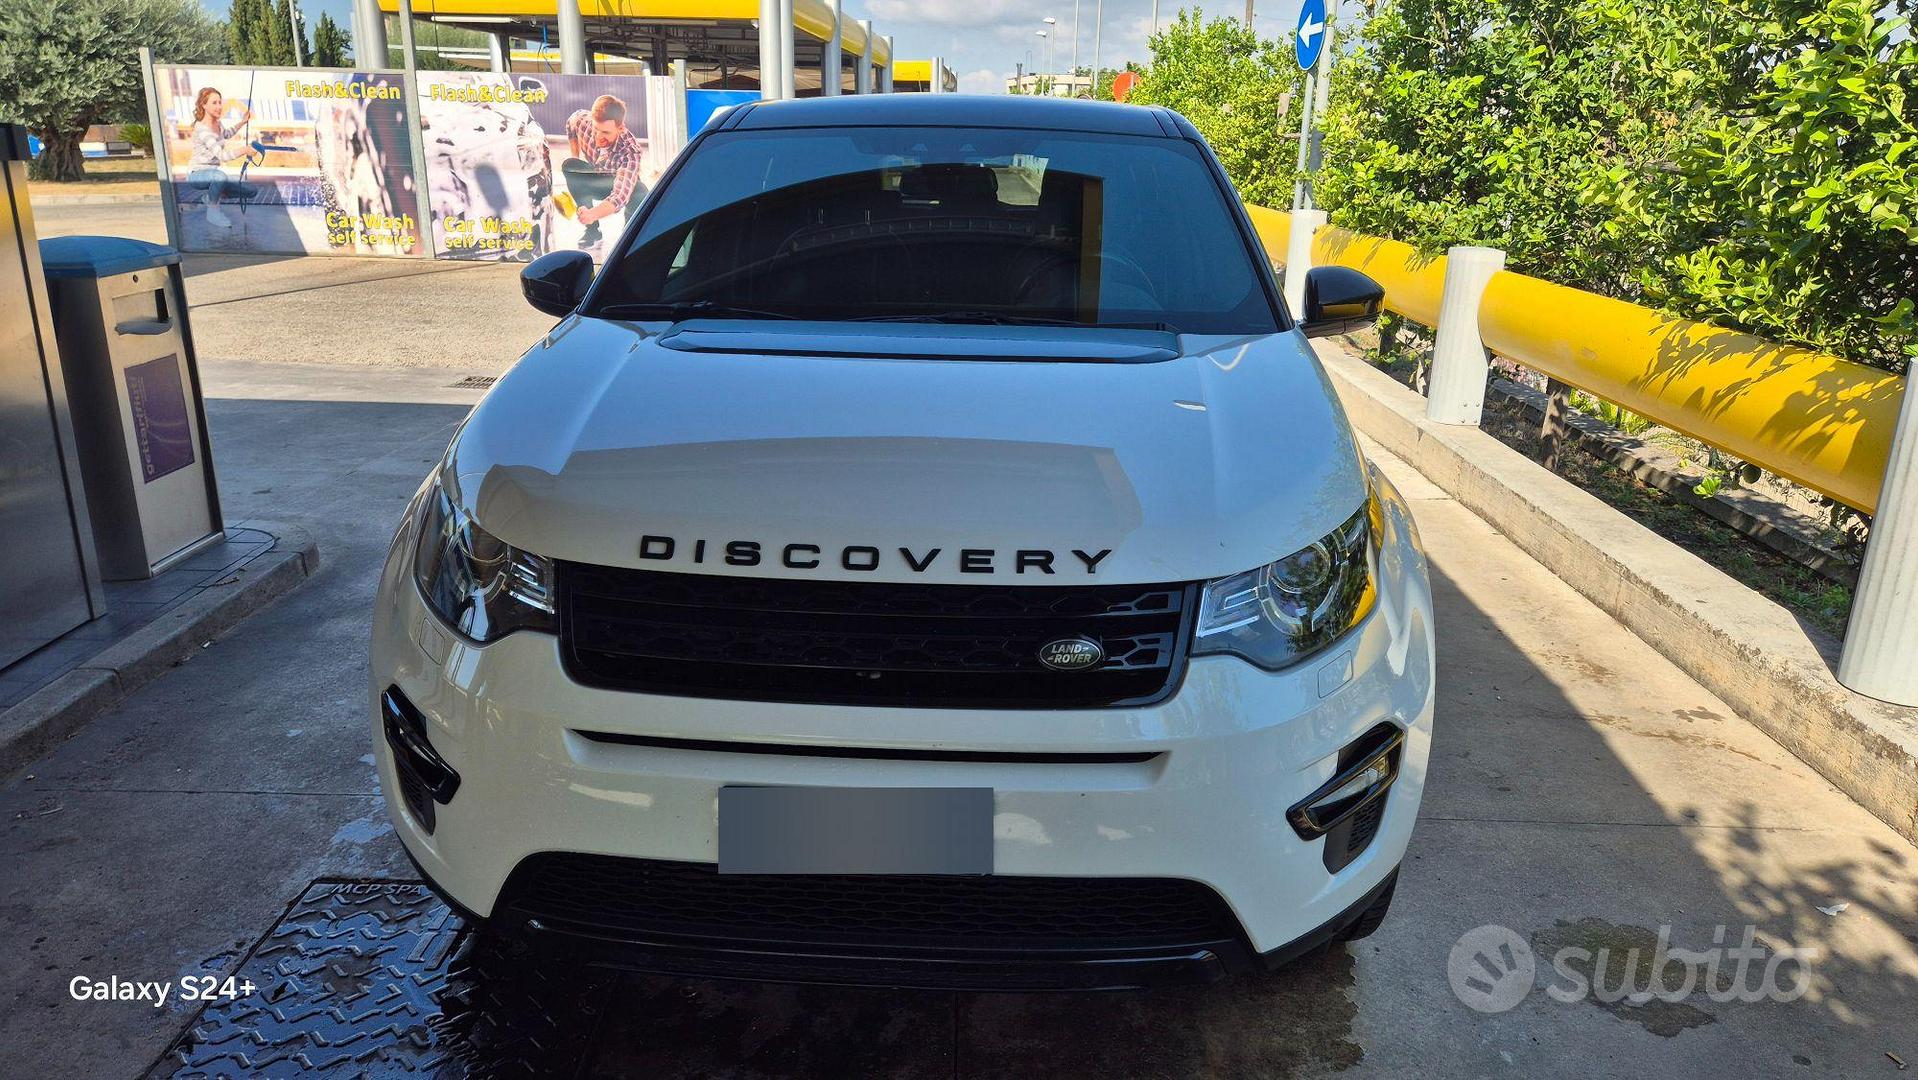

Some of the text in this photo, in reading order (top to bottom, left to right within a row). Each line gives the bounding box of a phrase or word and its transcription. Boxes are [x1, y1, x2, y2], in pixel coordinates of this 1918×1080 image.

[286, 79, 401, 100] Flash&Clean
[431, 83, 546, 103] Flash&Clean
[326, 211, 415, 230] Car Wash
[443, 215, 533, 235] Car Wash
[327, 230, 416, 246] self service
[444, 234, 534, 251] self service
[639, 534, 1112, 575] DISCOVERY
[331, 883, 423, 895] MCP SPA
